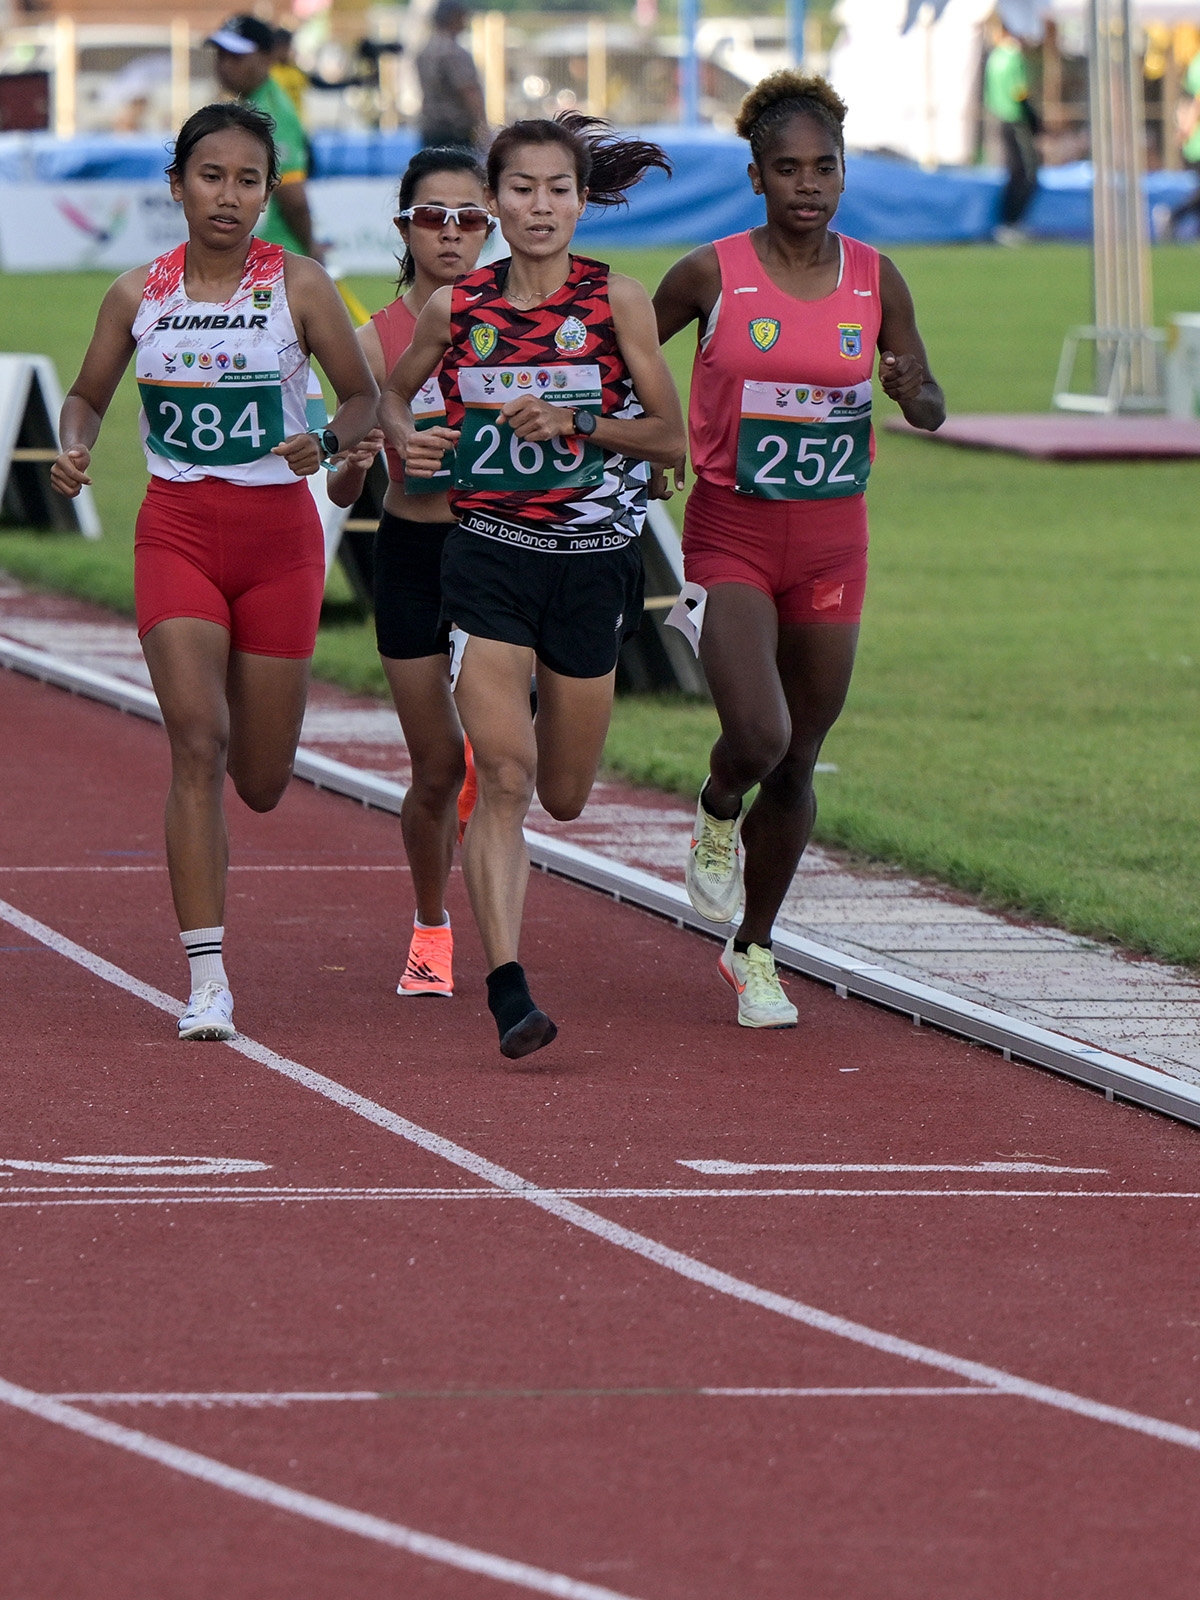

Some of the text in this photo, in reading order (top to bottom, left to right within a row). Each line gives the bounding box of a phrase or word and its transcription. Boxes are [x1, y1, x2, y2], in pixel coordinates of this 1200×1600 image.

[153, 315, 269, 331] SUMBAR
[159, 400, 266, 451] 284
[471, 424, 585, 475] 269
[754, 434, 856, 486] 252
[468, 516, 558, 549] new balance
[570, 538, 599, 549] new
